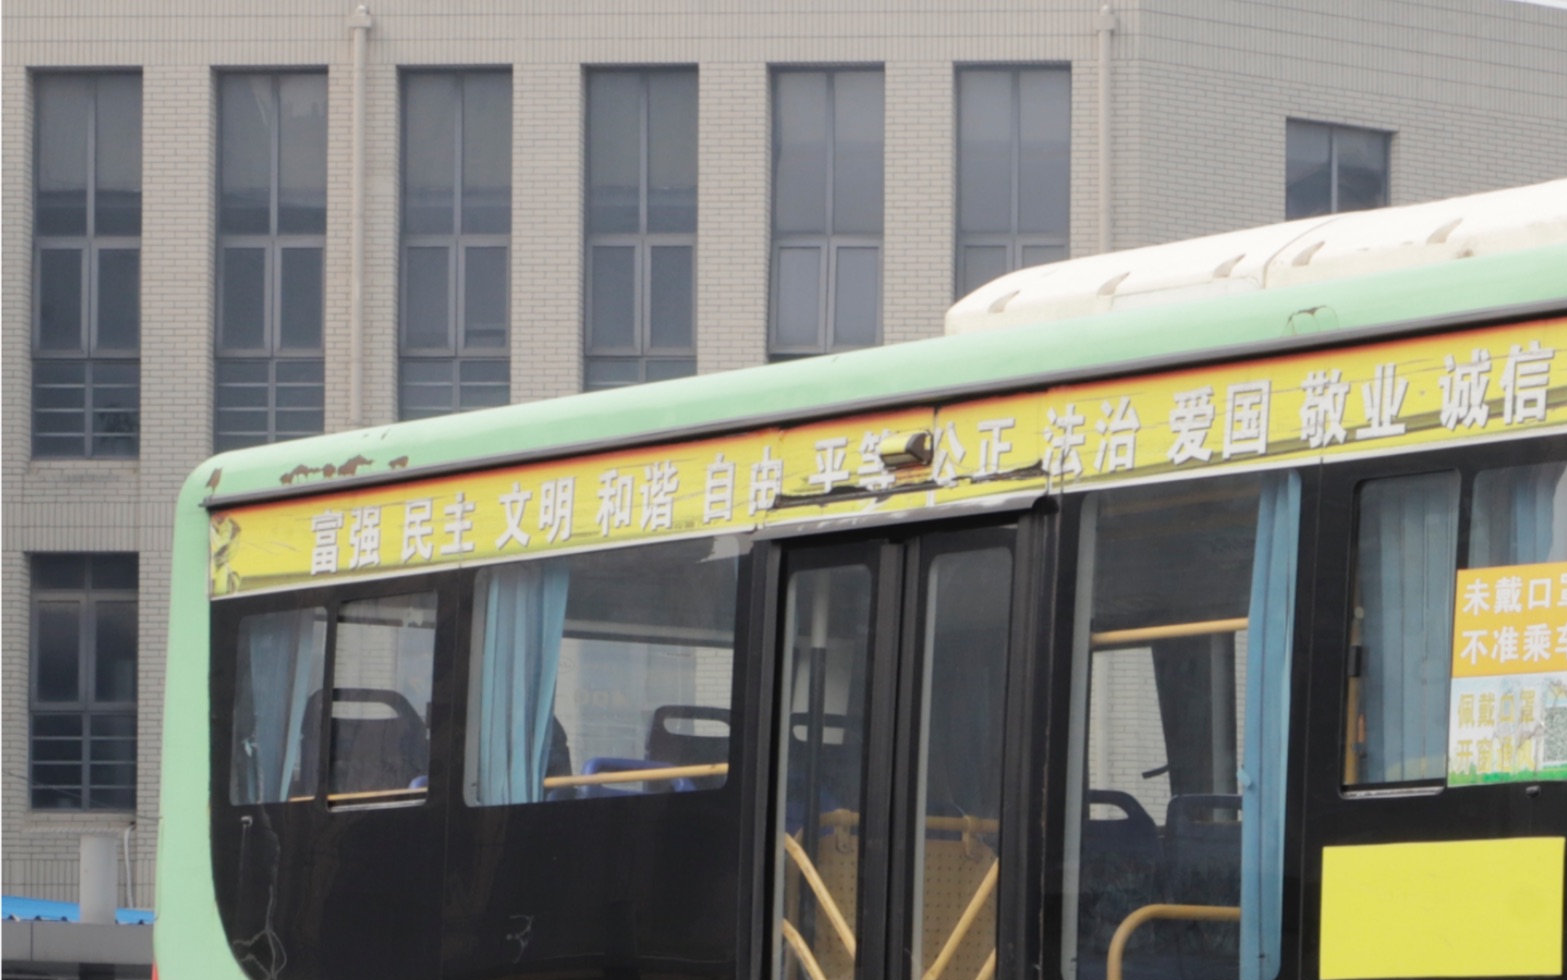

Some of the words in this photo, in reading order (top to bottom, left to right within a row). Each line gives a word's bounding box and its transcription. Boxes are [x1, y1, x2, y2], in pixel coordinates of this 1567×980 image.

[310, 505, 382, 576] 富强
[402, 492, 475, 563] 民主
[495, 476, 576, 549] 文明
[595, 460, 679, 537] 和谐
[702, 446, 783, 524] 自由
[931, 417, 1015, 487] 公正
[1042, 396, 1141, 478] 法治
[1167, 379, 1271, 465] 爱国
[1300, 363, 1408, 449] 敬业
[1439, 340, 1555, 430] 诚信
[1457, 689, 1536, 728] 佩戴口罩
